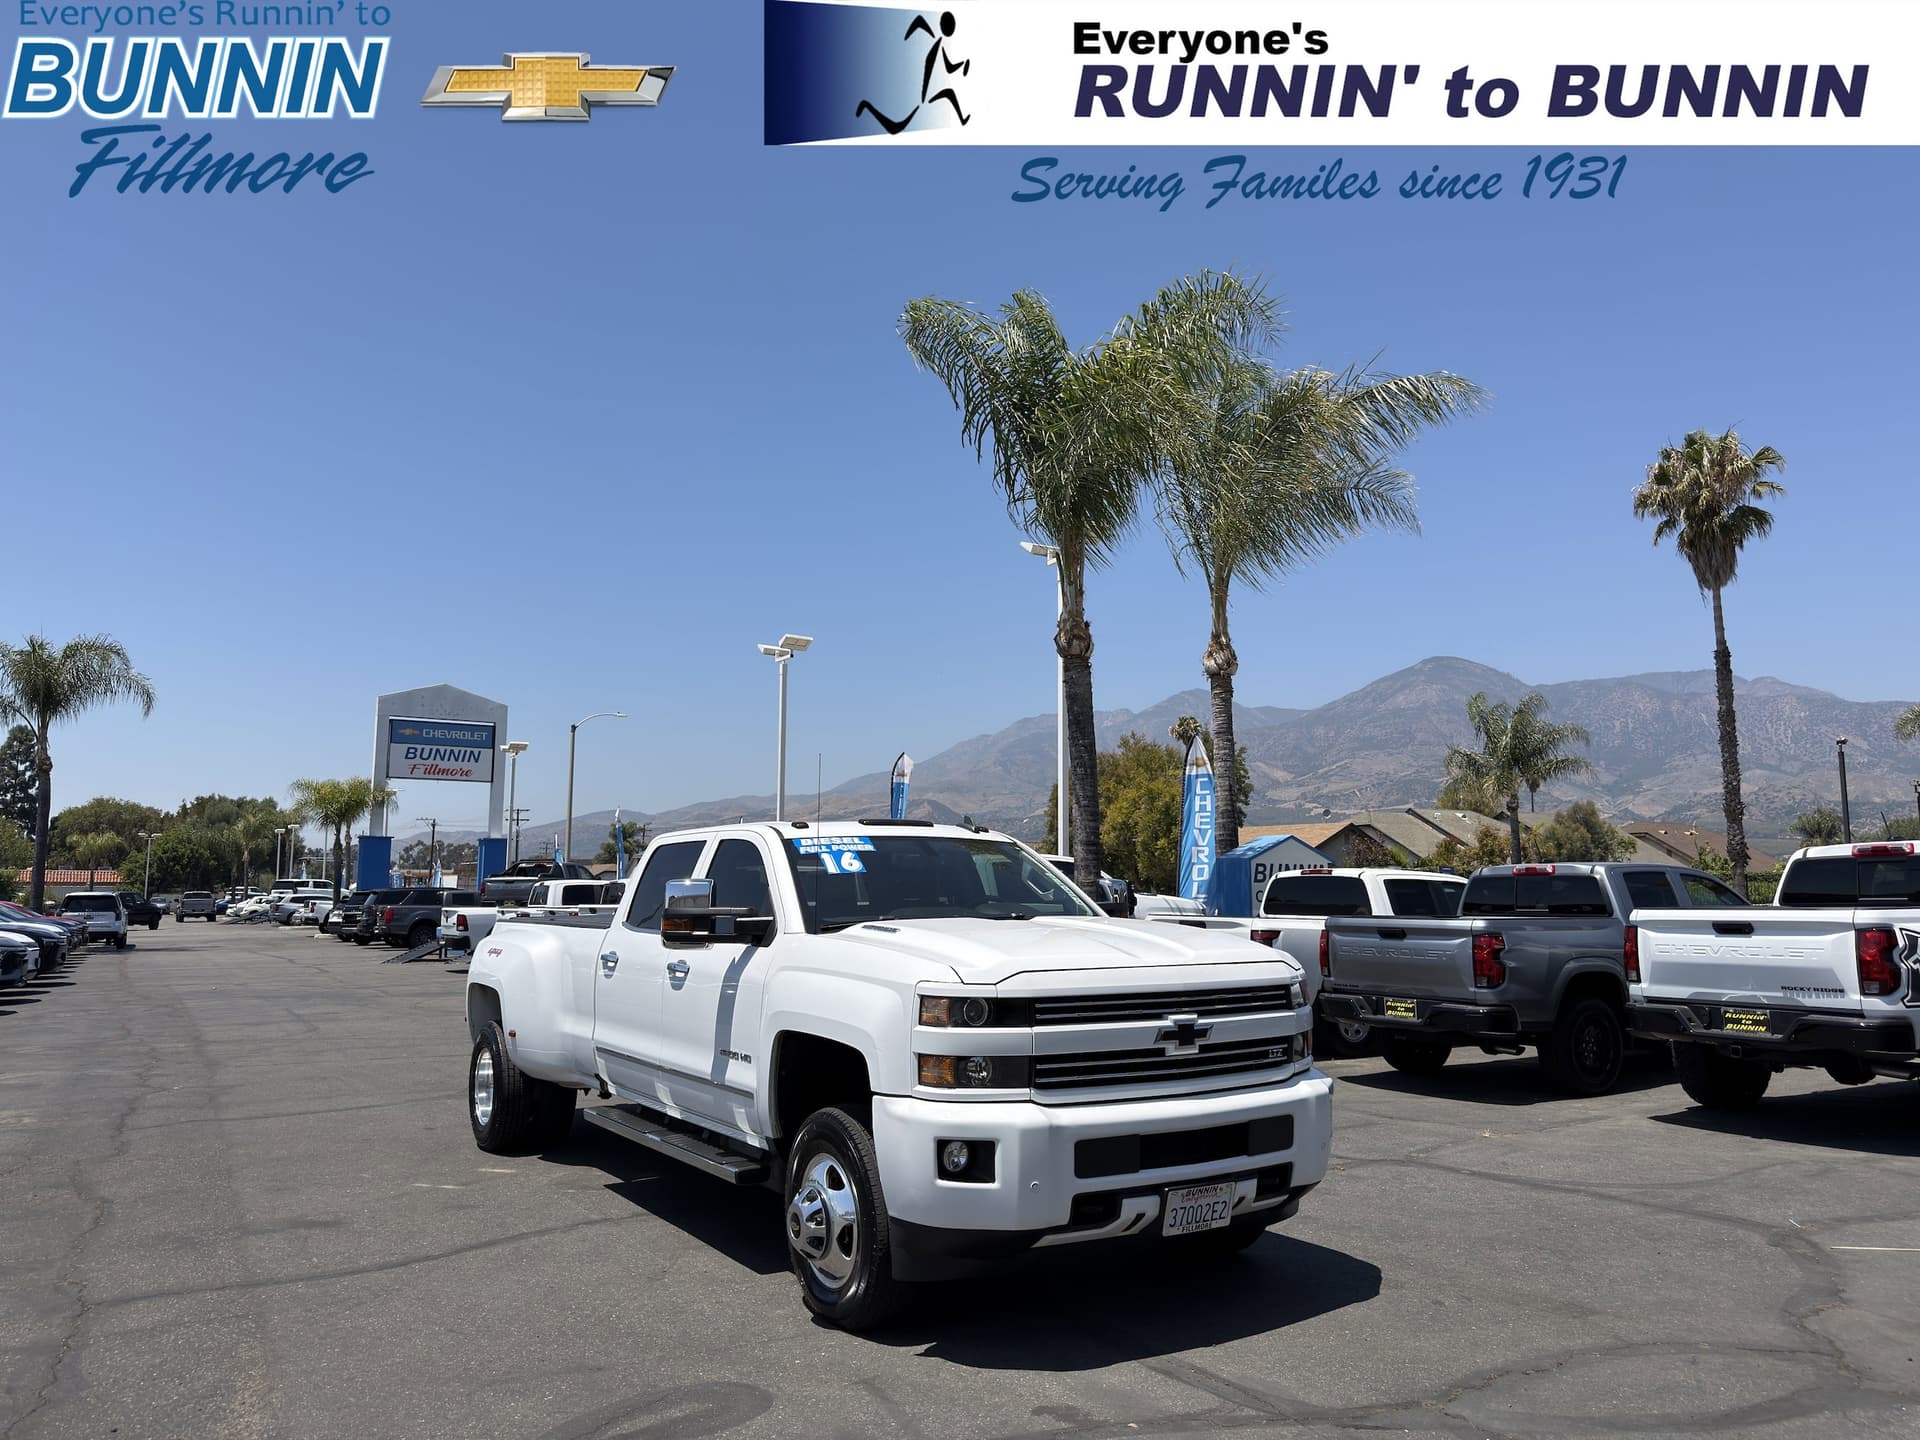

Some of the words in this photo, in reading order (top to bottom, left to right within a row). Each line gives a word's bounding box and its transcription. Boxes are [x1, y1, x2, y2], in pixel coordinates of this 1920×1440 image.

[422, 729, 488, 741] CHEVROLET
[404, 747, 482, 763] BUNNIN
[408, 763, 474, 777] Fillmore
[800, 837, 864, 846] DIESEL
[1191, 778, 1213, 900] CHEVROL
[800, 845, 830, 854] FULL
[821, 852, 863, 874] 16
[1339, 946, 1456, 960] CHEVROLET
[1655, 943, 1825, 960] CHEVROLET
[1726, 1023, 1766, 1032] BUNNIN
[1186, 1185, 1219, 1197] BUNNIN
[1168, 1200, 1228, 1228] 37002E2
